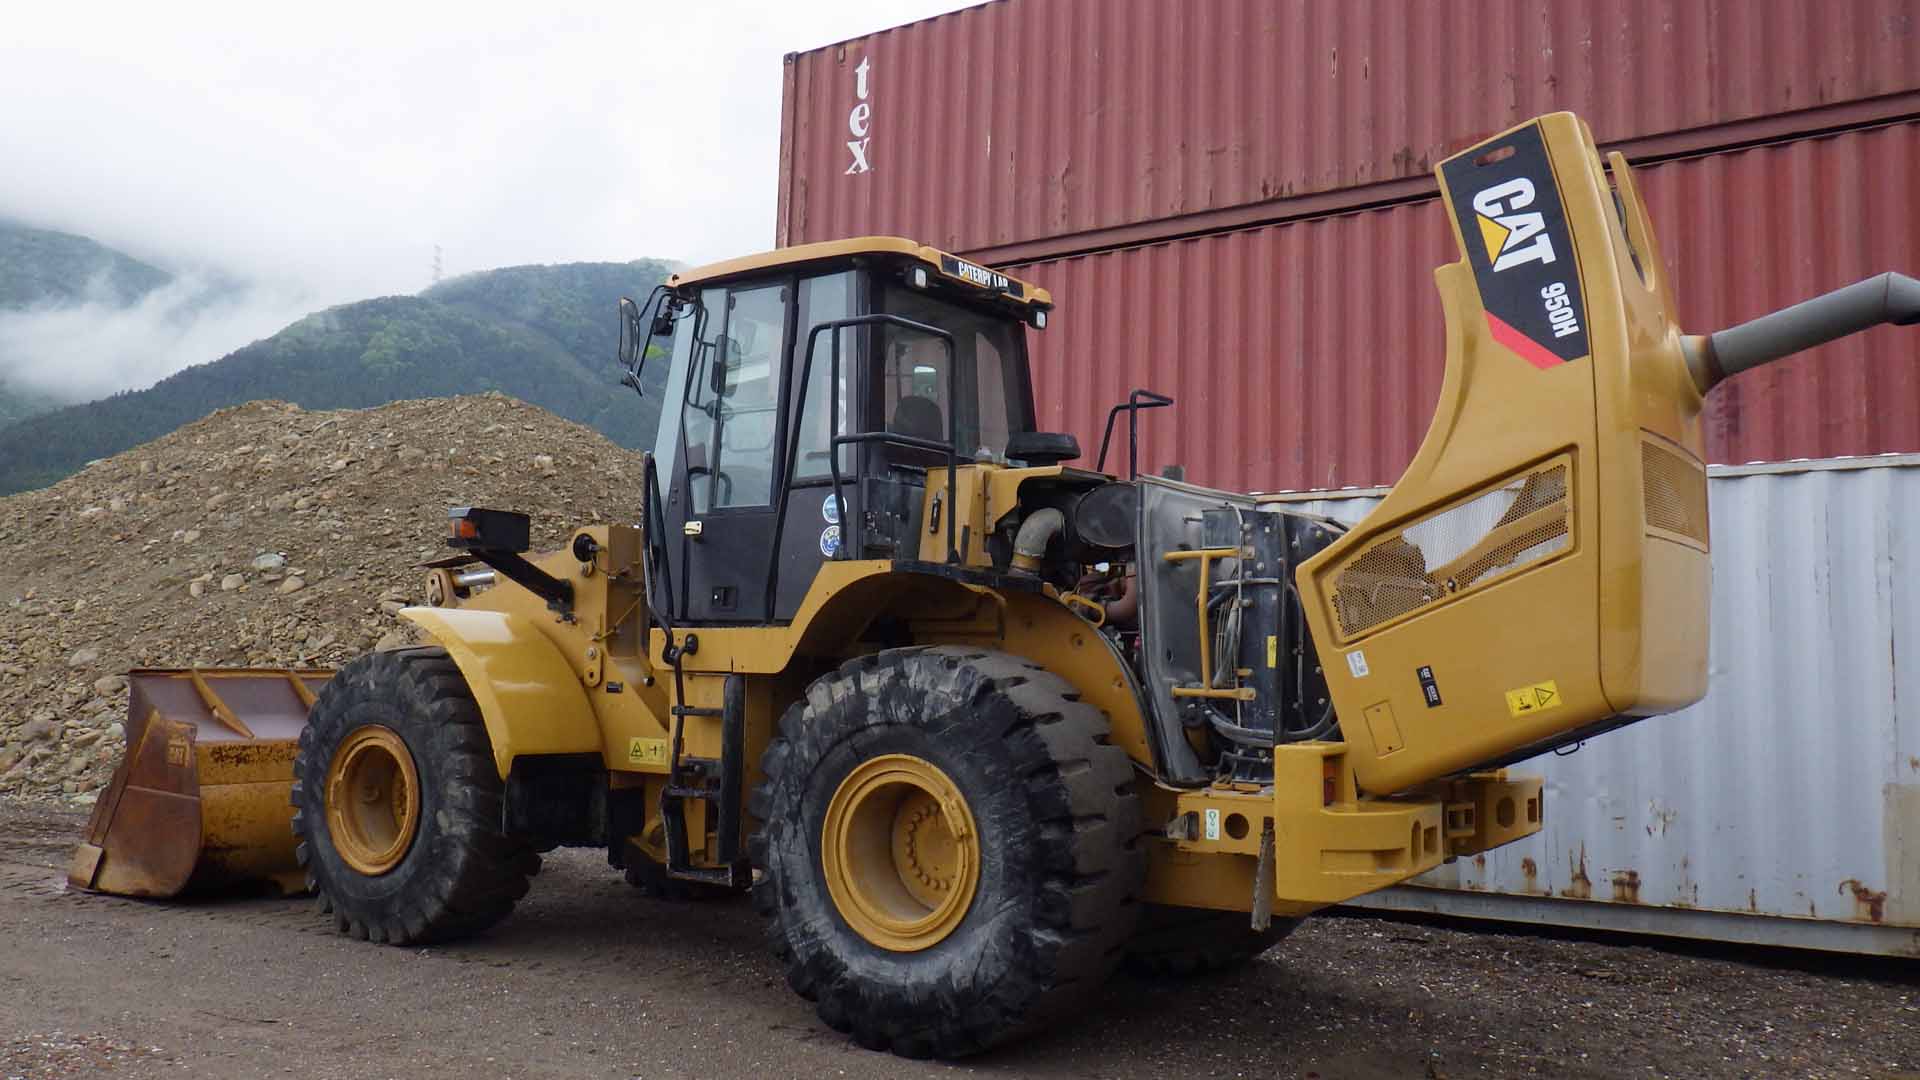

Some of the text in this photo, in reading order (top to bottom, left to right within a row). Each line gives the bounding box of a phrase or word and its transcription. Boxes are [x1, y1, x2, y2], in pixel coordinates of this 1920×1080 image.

[844, 55, 870, 175] tex
[1473, 177, 1557, 273] CAT
[1541, 282, 1580, 338] 950H
